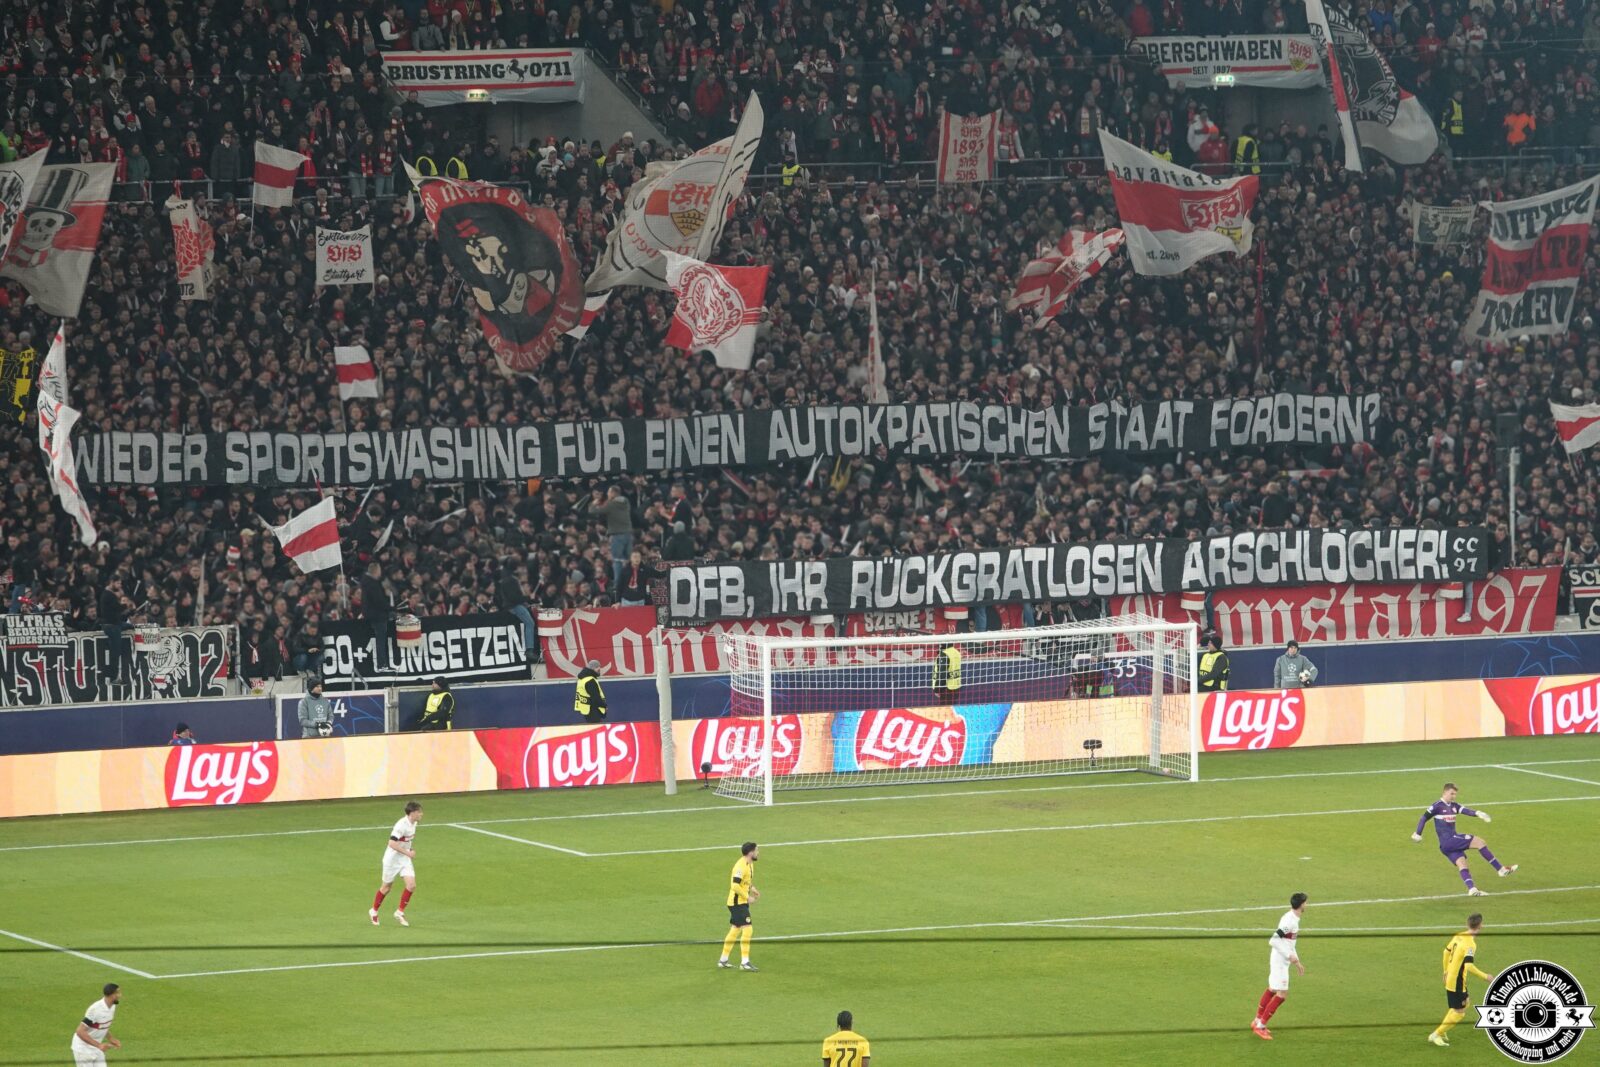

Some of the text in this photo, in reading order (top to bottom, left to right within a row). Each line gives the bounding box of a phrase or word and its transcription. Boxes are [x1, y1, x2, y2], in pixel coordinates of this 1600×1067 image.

[387, 61, 572, 81] BRUSTRING 0711
[1192, 65, 1208, 75] SEIT
[327, 243, 363, 263] VfB
[76, 430, 208, 483] WIEDER
[226, 426, 541, 484] SPORTSWASHING
[554, 421, 628, 476] FÜR
[646, 413, 746, 470] EINEN
[768, 401, 1070, 461] AUTOKRATISCHEN
[1088, 400, 1194, 451] STAAT
[670, 565, 755, 618] DFB,
[769, 561, 829, 614] IHR
[850, 541, 1165, 610] RÜCKGRATLOSEN
[1181, 528, 1450, 589] ARSCHLÖCHER!
[1453, 557, 1478, 573] 97
[1477, 573, 1548, 635] 97
[7, 614, 65, 628] ULTRAS
[8, 627, 66, 637] BEDEUTET
[864, 608, 921, 633] SZENE
[8, 634, 69, 645] WIDERSTAND
[387, 622, 527, 674] UMSETZEN
[1112, 658, 1137, 678] 35
[1207, 689, 1300, 750] Lay's
[699, 715, 796, 778] Lay's
[861, 709, 960, 768] Lay's
[537, 724, 628, 788] Lay's
[171, 741, 273, 805] Lay's
[836, 1047, 857, 1067] 77
